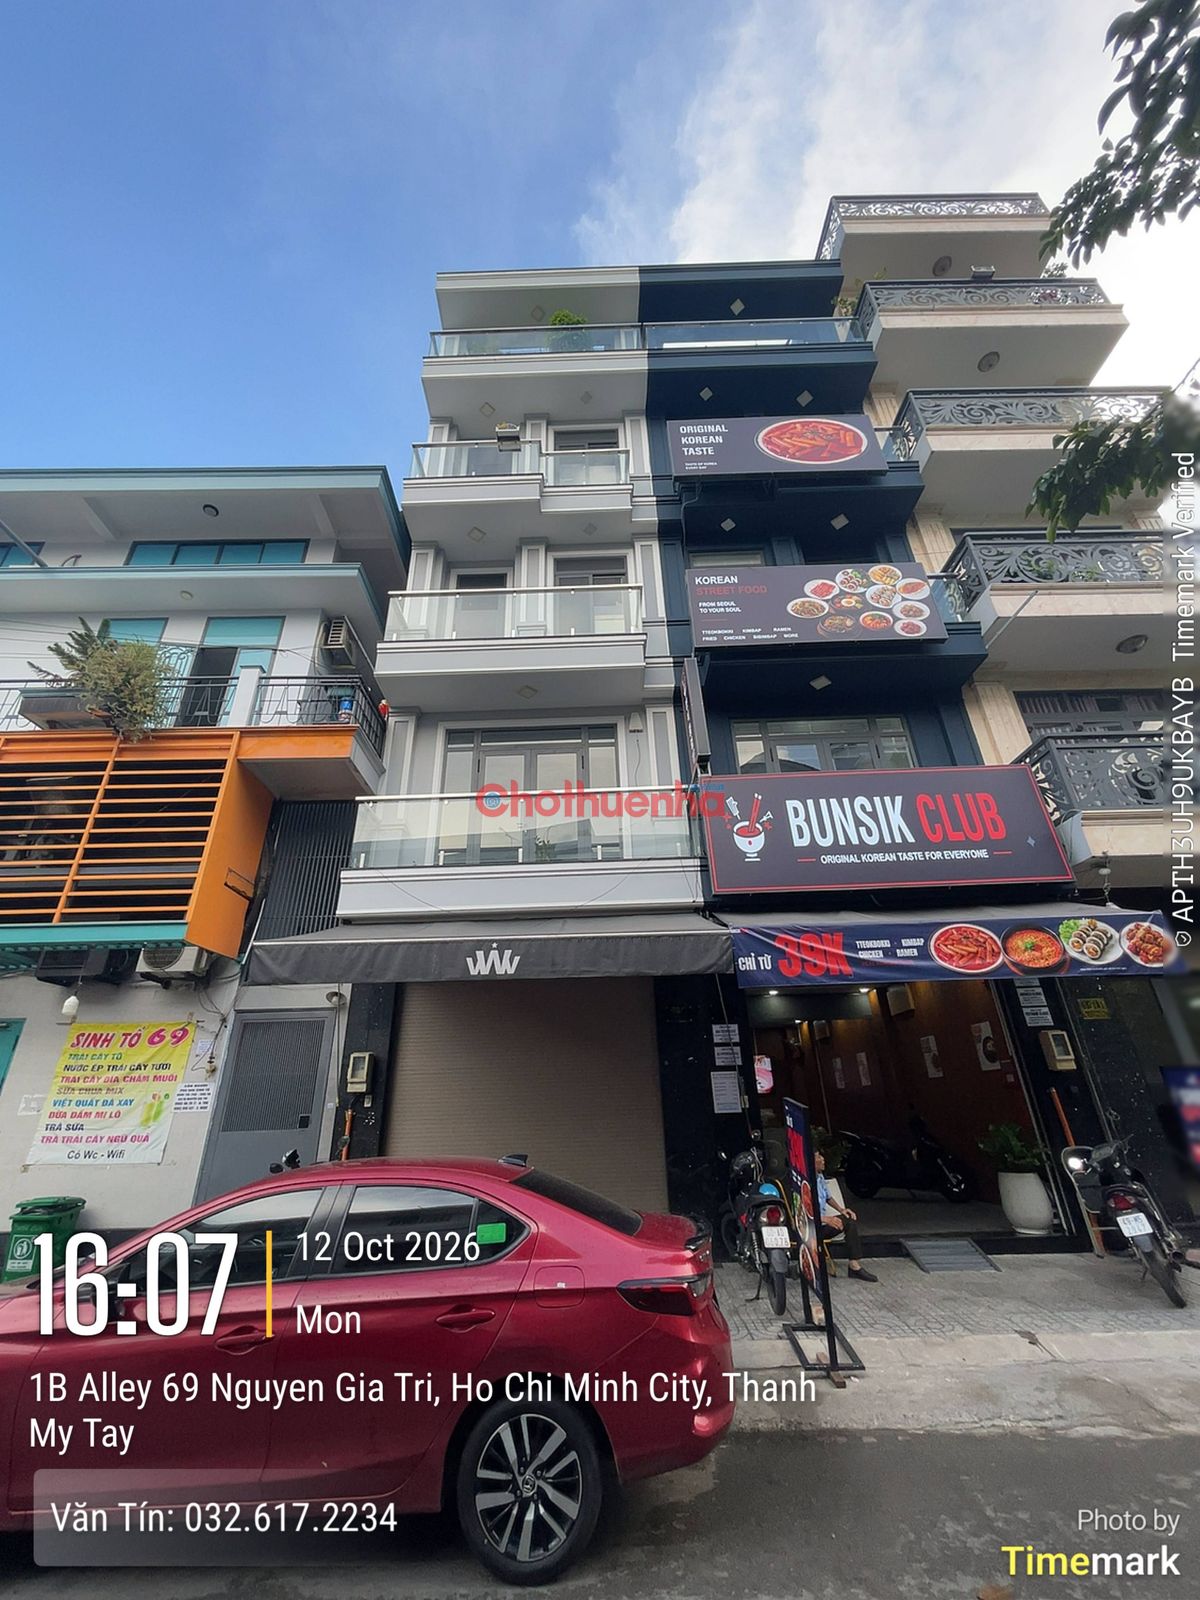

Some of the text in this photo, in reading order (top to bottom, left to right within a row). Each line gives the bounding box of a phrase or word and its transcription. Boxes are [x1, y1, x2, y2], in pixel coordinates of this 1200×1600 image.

[680, 424, 729, 433] ORIGINAL
[681, 435, 723, 444] KOREAN
[682, 446, 715, 455] TASTE
[694, 575, 738, 585] KOREAN
[696, 585, 768, 596] STREET FOOD
[785, 792, 1007, 848] BUNSIK CLUB
[820, 849, 989, 864] ORIGINAL KOREAN TASTE FOR EVERYONE
[774, 932, 854, 978] 39K
[896, 948, 919, 958] RAMEN
[738, 953, 772, 971] CHỈ TỪ
[70, 1032, 115, 1048] SINH
[119, 1026, 147, 1048] TỐ
[147, 1027, 190, 1047] 69
[67, 1149, 80, 1159] Có
[83, 1150, 98, 1159] Wc
[106, 1149, 126, 1159] Wifi
